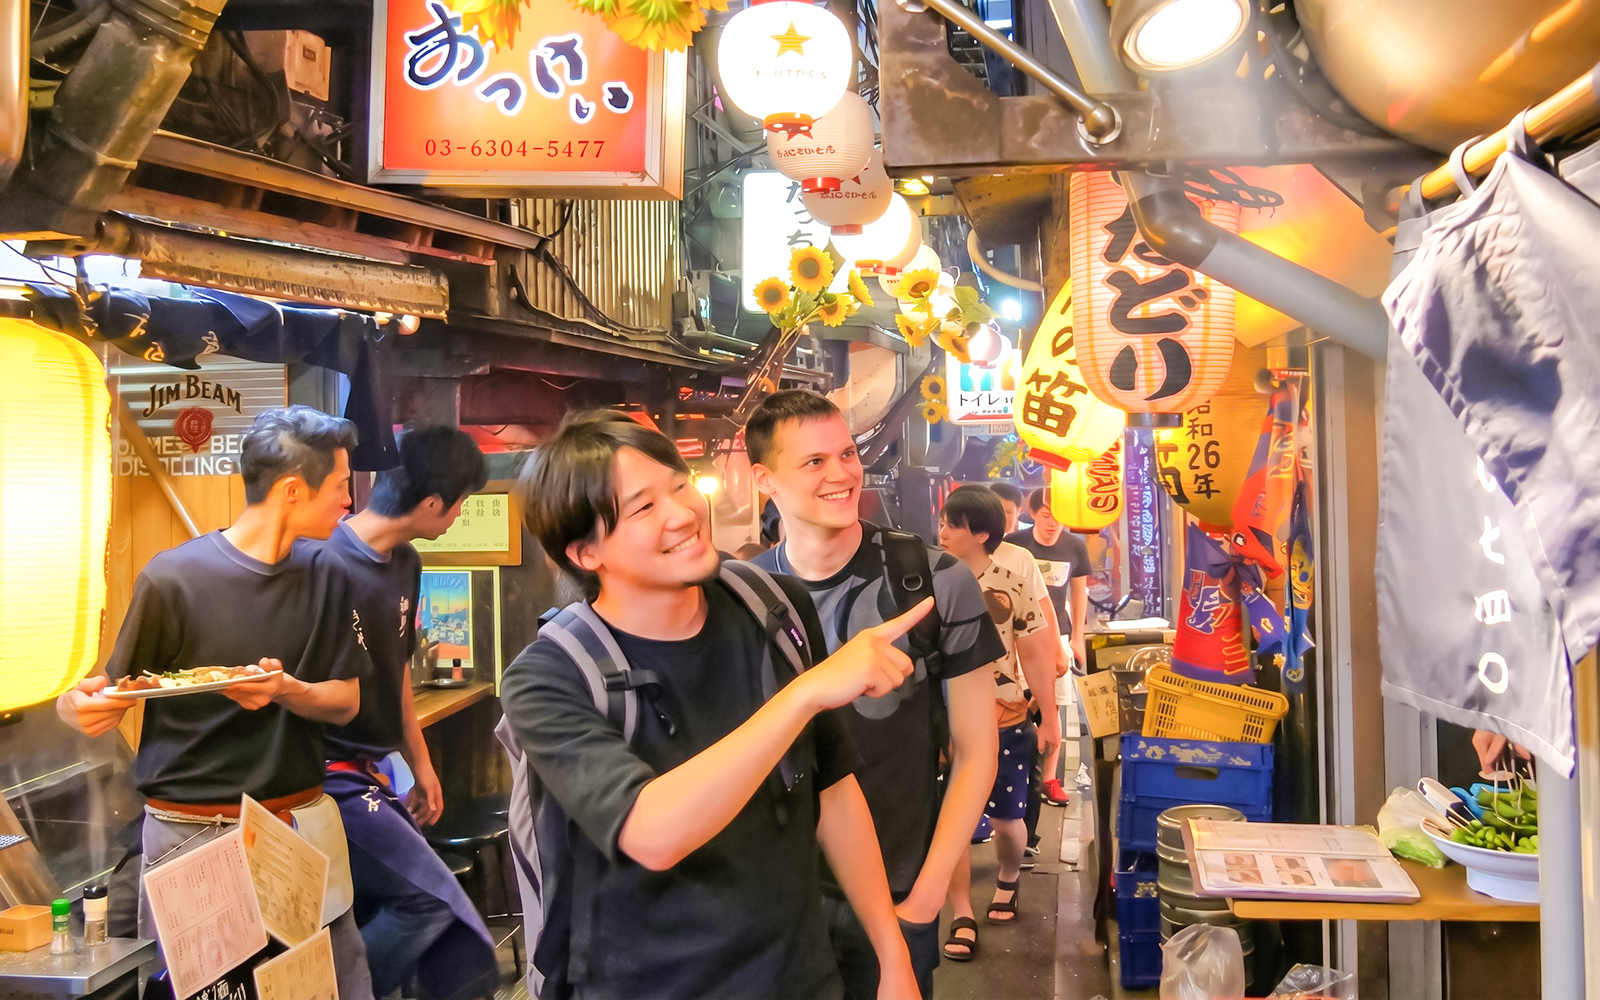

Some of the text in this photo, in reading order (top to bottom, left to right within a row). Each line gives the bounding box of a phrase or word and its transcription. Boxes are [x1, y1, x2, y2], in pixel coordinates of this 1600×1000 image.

[425, 139, 606, 158] 03-6304-5477
[142, 374, 242, 418] JIM BEAM
[959, 392, 1000, 407] トイレ
